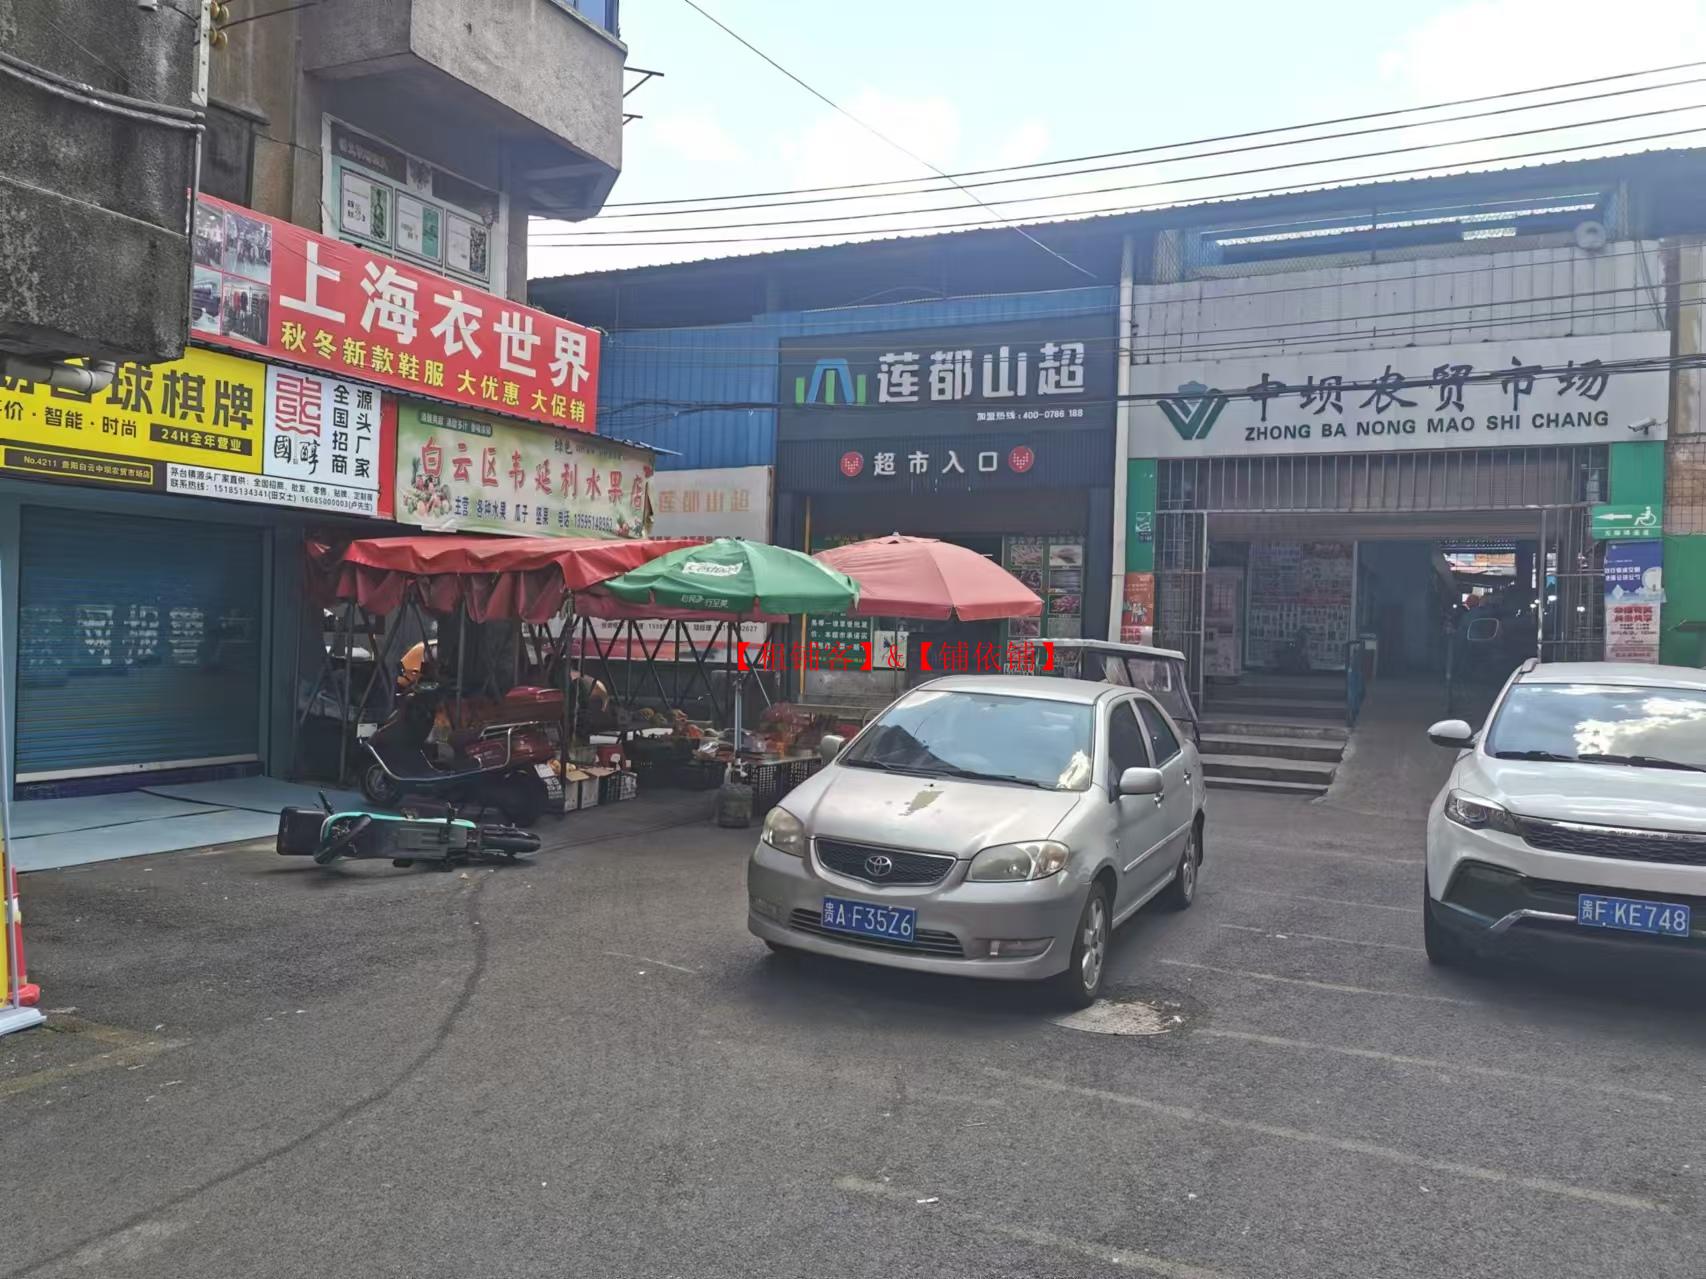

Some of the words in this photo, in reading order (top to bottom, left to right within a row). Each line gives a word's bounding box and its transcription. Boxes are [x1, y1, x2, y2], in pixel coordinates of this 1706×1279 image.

[278, 240, 589, 393] 上海衣世界
[280, 319, 445, 388] 秋冬新款鞋服
[457, 369, 521, 407] 大优惠
[530, 387, 586, 424] 大促销
[877, 342, 1085, 404] 莲都山超
[1247, 356, 1612, 422] 中坝农贸市场
[332, 384, 349, 475] 全国招商
[354, 389, 372, 479] 源头厂家
[1068, 408, 1084, 418] 188
[1245, 424, 1311, 442] ZHONG
[1321, 422, 1347, 438] BA
[1356, 419, 1416, 437] NONG
[1427, 416, 1476, 434] MAO
[1486, 414, 1521, 431] SHI
[1532, 410, 1609, 429] CHANG
[23, 455, 57, 468] No.4211
[160, 428, 242, 452] 24H全年营业
[873, 450, 999, 477] 超市入口
[476, 500, 507, 519] 各种水果
